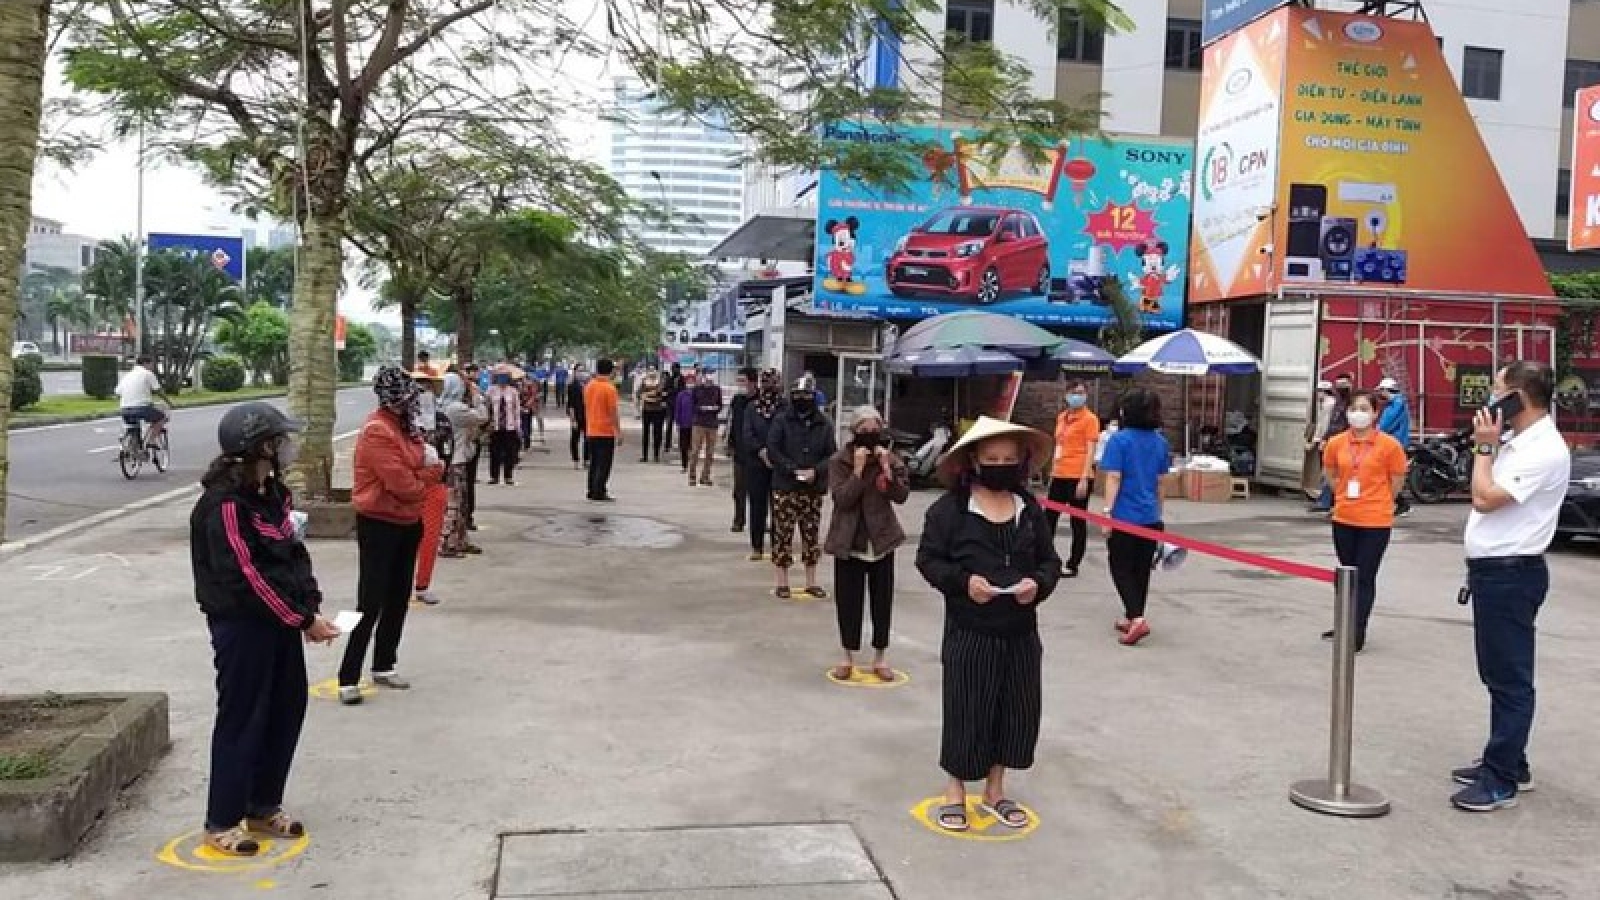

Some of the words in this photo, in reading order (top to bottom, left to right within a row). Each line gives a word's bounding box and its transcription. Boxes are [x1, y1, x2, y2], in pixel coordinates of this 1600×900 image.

[1126, 148, 1187, 165] SONY
[1239, 149, 1269, 175] CPN
[1110, 207, 1137, 231] 12
